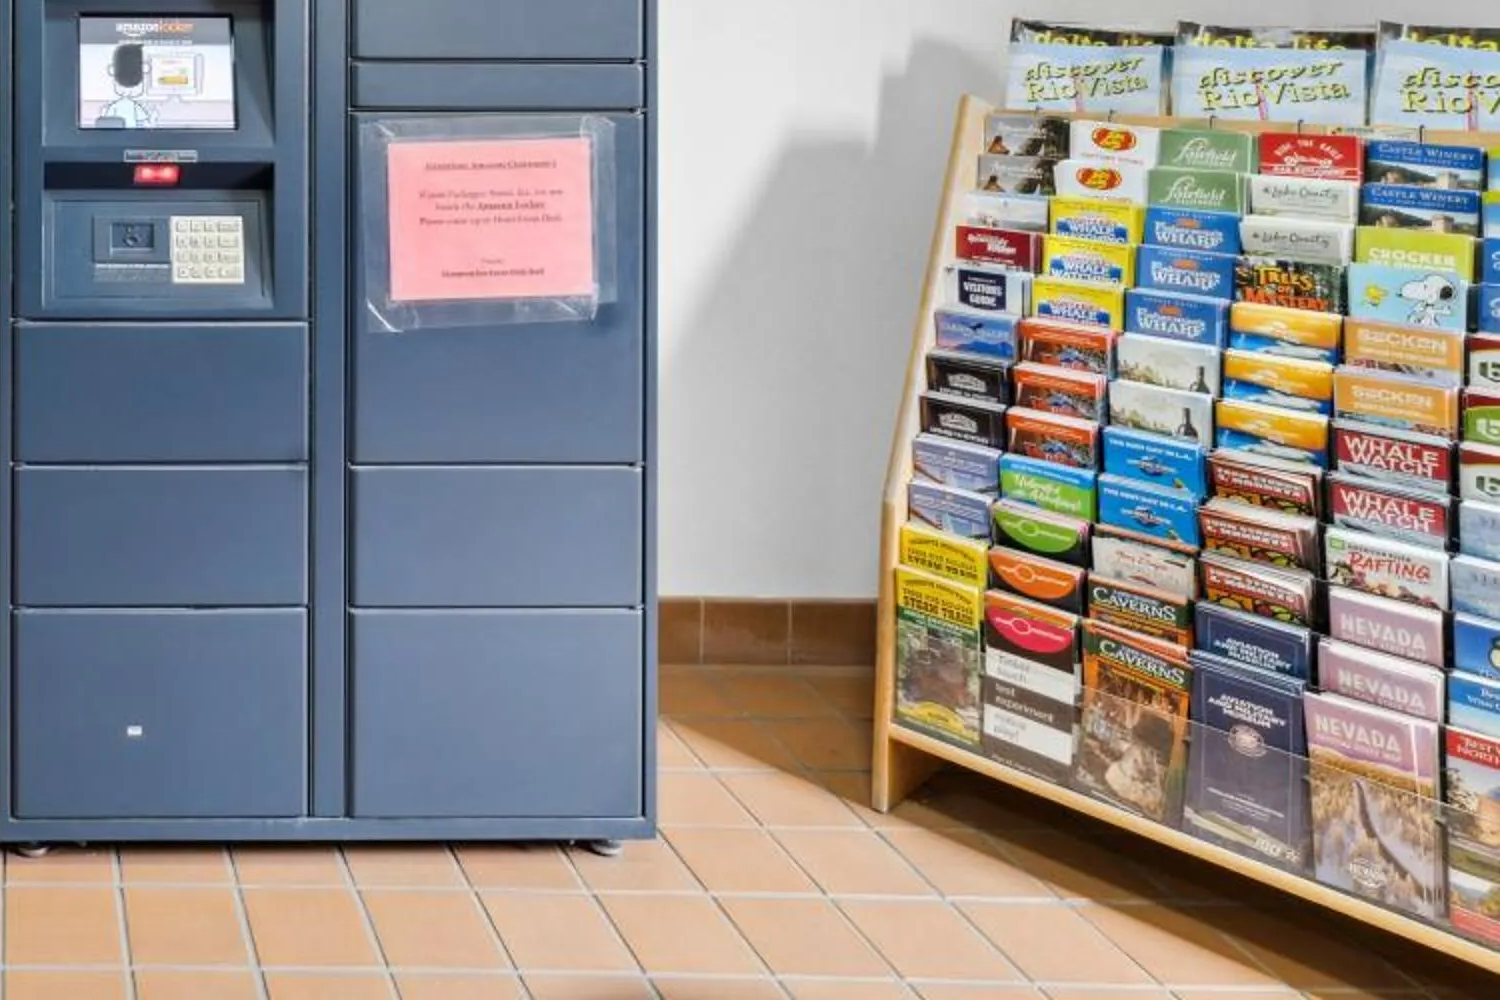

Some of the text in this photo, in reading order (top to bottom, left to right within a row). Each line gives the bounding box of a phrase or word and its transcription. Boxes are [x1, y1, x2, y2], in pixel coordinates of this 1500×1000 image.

[1026, 57, 1144, 82] discover
[1200, 61, 1343, 89] discover
[1027, 75, 1148, 102] Rio Vista
[1201, 81, 1351, 110] Rio Vista
[1401, 90, 1473, 113] Rio
[1378, 143, 1476, 162] CASTLE WINERY
[1371, 186, 1470, 205] CASTLE WINERY
[1156, 231, 1218, 249] WHARF
[1368, 247, 1457, 267] CROCKER
[1152, 270, 1215, 291] WHARF
[1254, 265, 1315, 292] TREES
[1244, 288, 1329, 311] MYSTERY
[1139, 316, 1201, 338] WHARF
[1344, 434, 1440, 468] WHALE
[1350, 449, 1439, 478] WATCH
[1340, 488, 1436, 521] WHALE
[1346, 502, 1431, 533] WATCH
[1348, 551, 1432, 583] RAFTING
[1093, 586, 1177, 621] CAVERNS
[1340, 612, 1427, 652] NEVADA
[1100, 639, 1186, 684] CAVERNS
[1337, 668, 1426, 711] NEVADA
[1314, 713, 1401, 753] NEVADA
